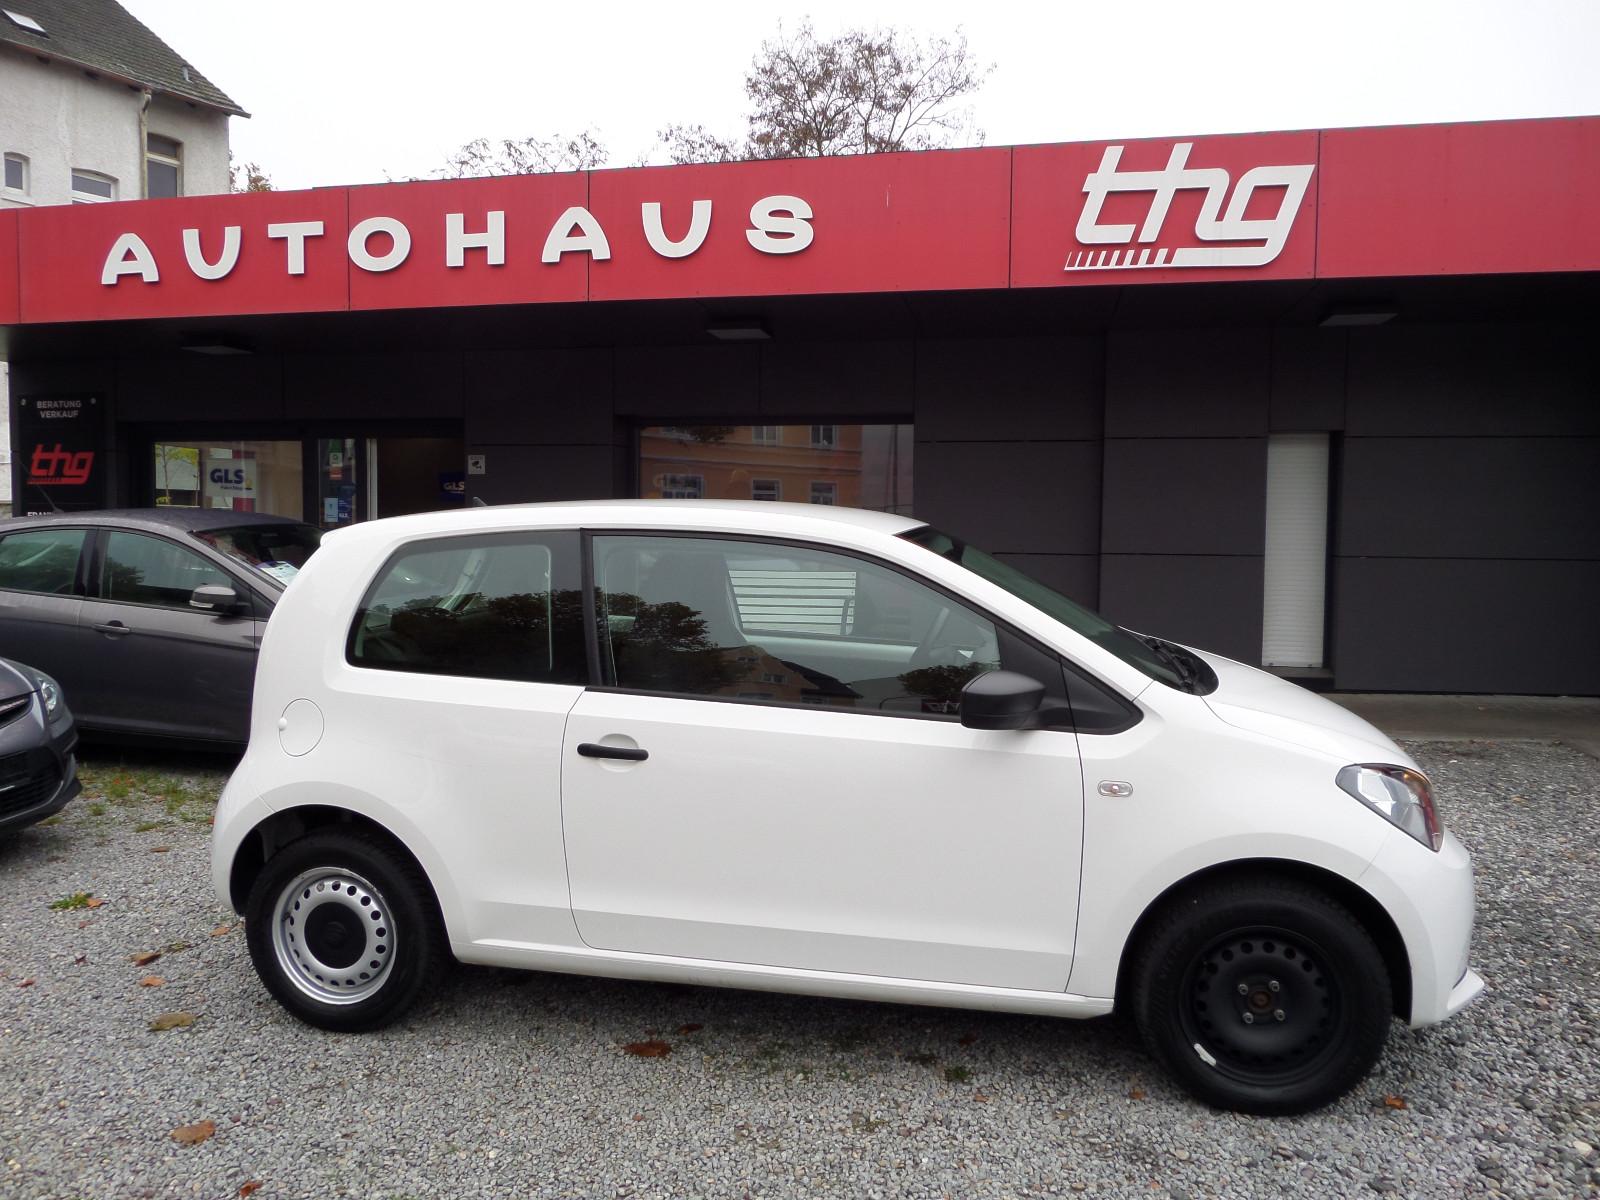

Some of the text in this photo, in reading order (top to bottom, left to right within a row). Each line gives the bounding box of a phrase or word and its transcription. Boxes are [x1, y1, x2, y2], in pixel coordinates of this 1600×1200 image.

[1063, 142, 1316, 271] thg
[100, 194, 815, 285] AUTOHAUS
[36, 400, 82, 409] BERATUNG
[40, 410, 79, 419] VERKAUF
[27, 443, 95, 485] thg
[210, 468, 244, 484] GLS
[443, 481, 465, 491] GLS
